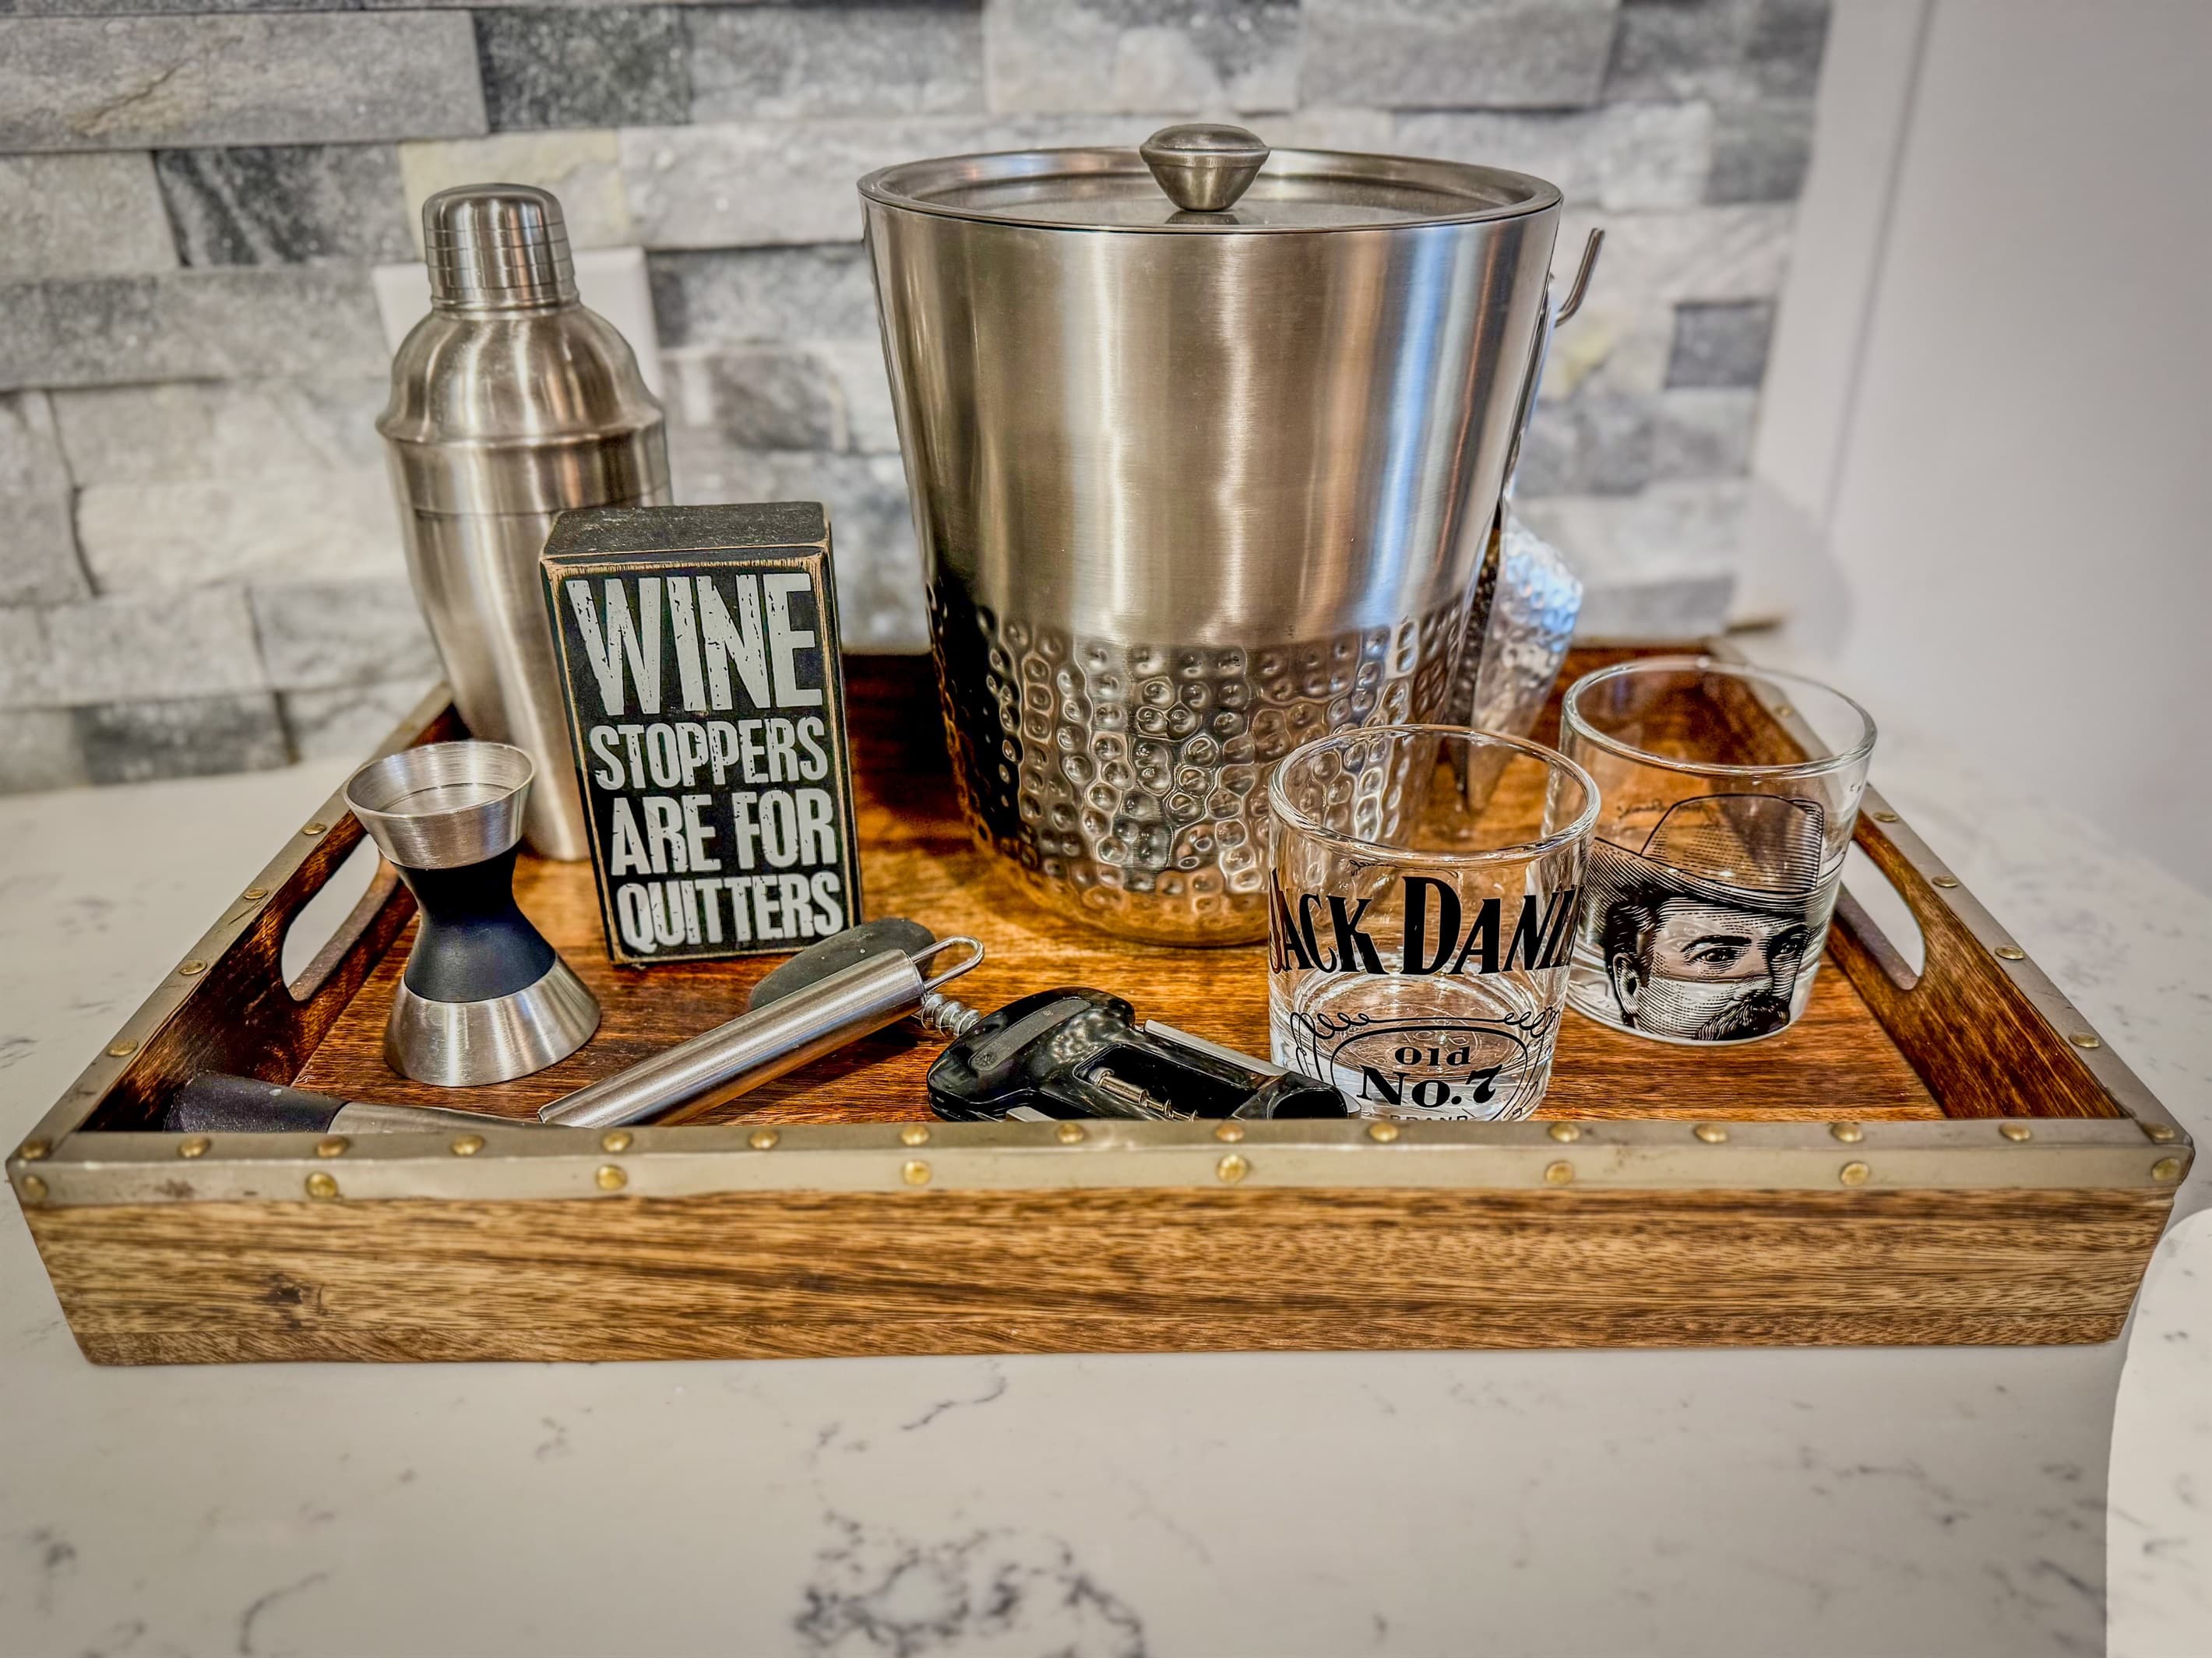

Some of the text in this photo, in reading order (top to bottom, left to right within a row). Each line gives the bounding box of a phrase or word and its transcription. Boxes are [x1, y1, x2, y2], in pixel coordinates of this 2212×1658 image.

[565, 572, 823, 716] WINE
[589, 716, 828, 790] STOPPERS
[611, 788, 837, 876] ARE FOR
[616, 872, 844, 954] QUITTERS
